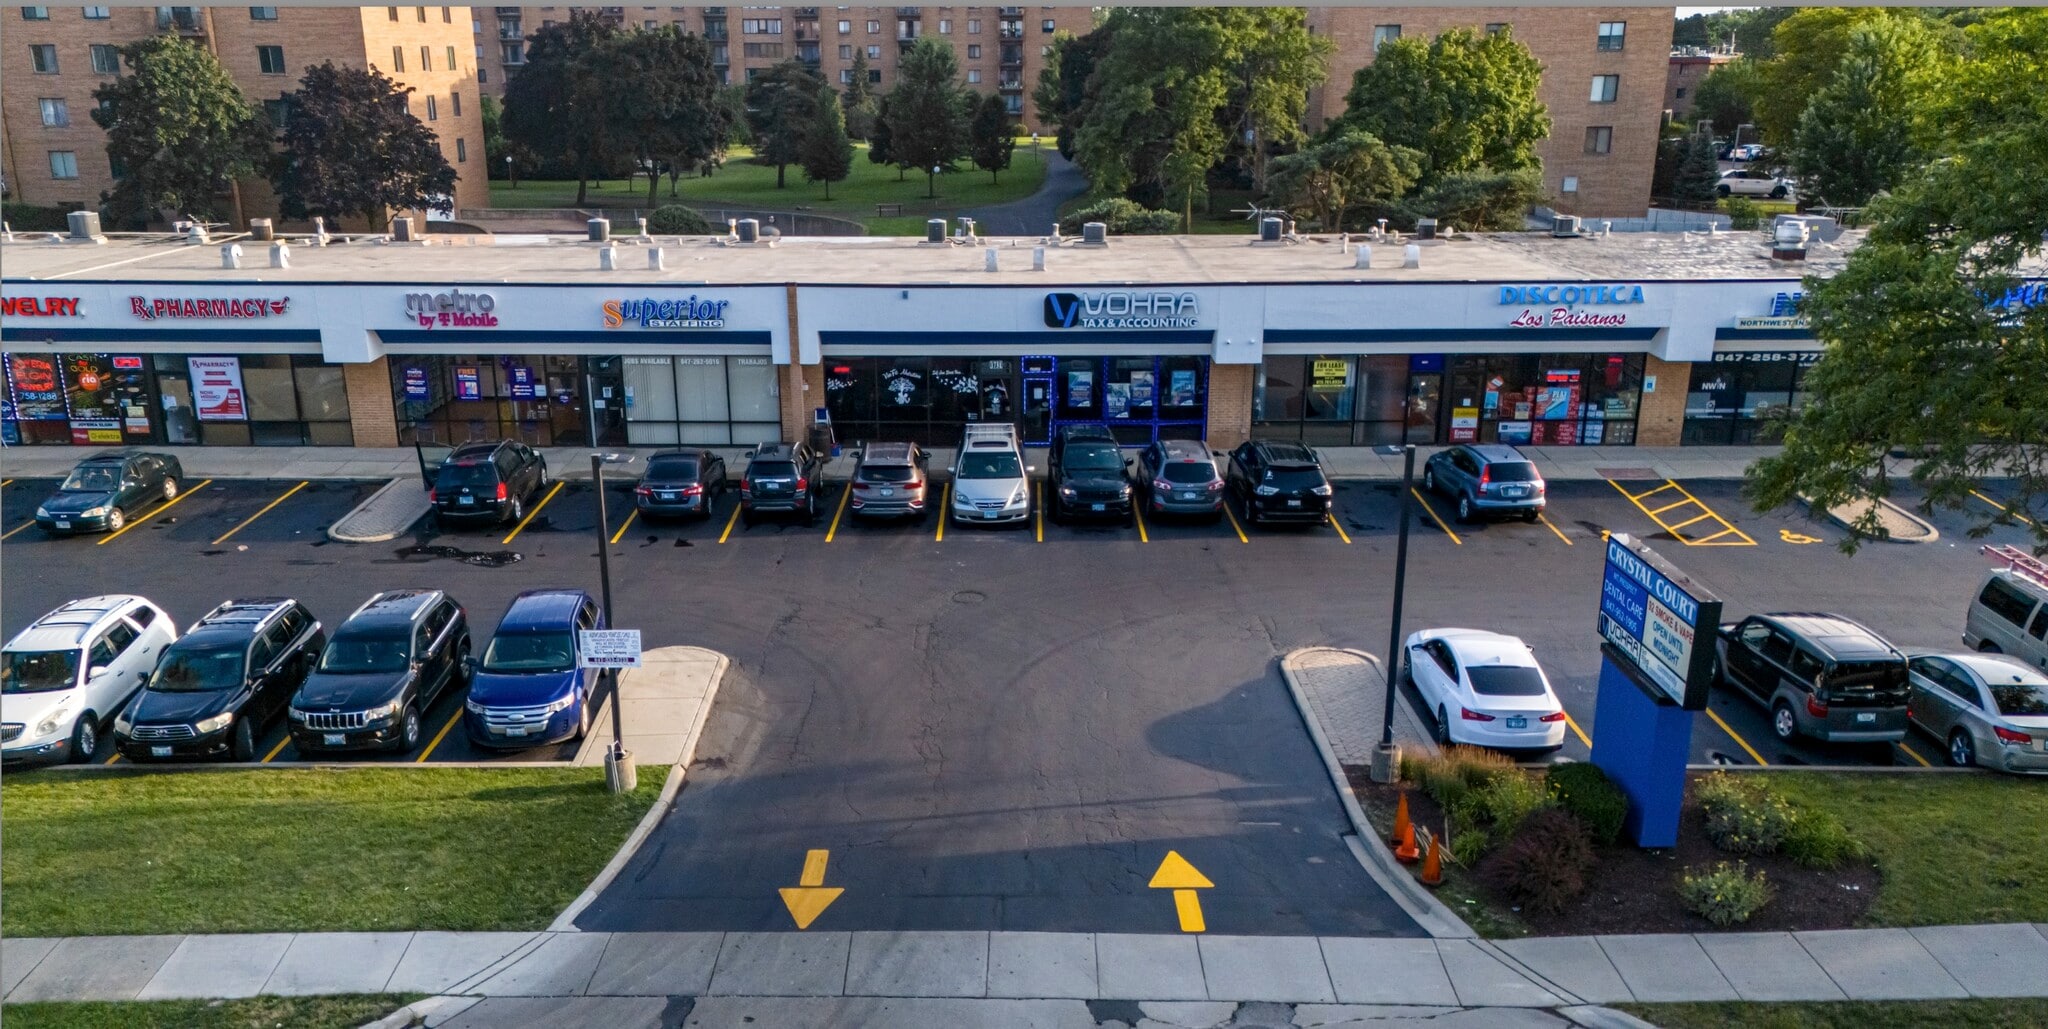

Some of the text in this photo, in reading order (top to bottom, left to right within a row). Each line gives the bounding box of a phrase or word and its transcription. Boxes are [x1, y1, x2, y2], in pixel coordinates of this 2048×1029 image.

[406, 289, 495, 312] metro
[1083, 293, 1199, 315] VOHRA
[1500, 286, 1645, 305] DISCOTECA
[153, 299, 267, 318] PHARMACY
[603, 295, 728, 327] Superior
[1510, 307, 1627, 327] Los Paisanos
[418, 312, 436, 329] by
[1083, 318, 1199, 328] TAX & ACCOUNTING
[1740, 319, 1791, 327] NORTHWEST
[70, 365, 98, 373] GOLD
[82, 374, 97, 384] ria
[1609, 543, 1697, 621] CRYSTAL COURT
[1604, 579, 1644, 621] DENTAL CARE
[1655, 604, 1674, 629] SMOKE
[1679, 624, 1694, 645] VAPE
[1609, 621, 1640, 659] VOHRA
[1653, 621, 1683, 655] OPEN UNTIL
[1653, 638, 1680, 666] MIDNIGHT
